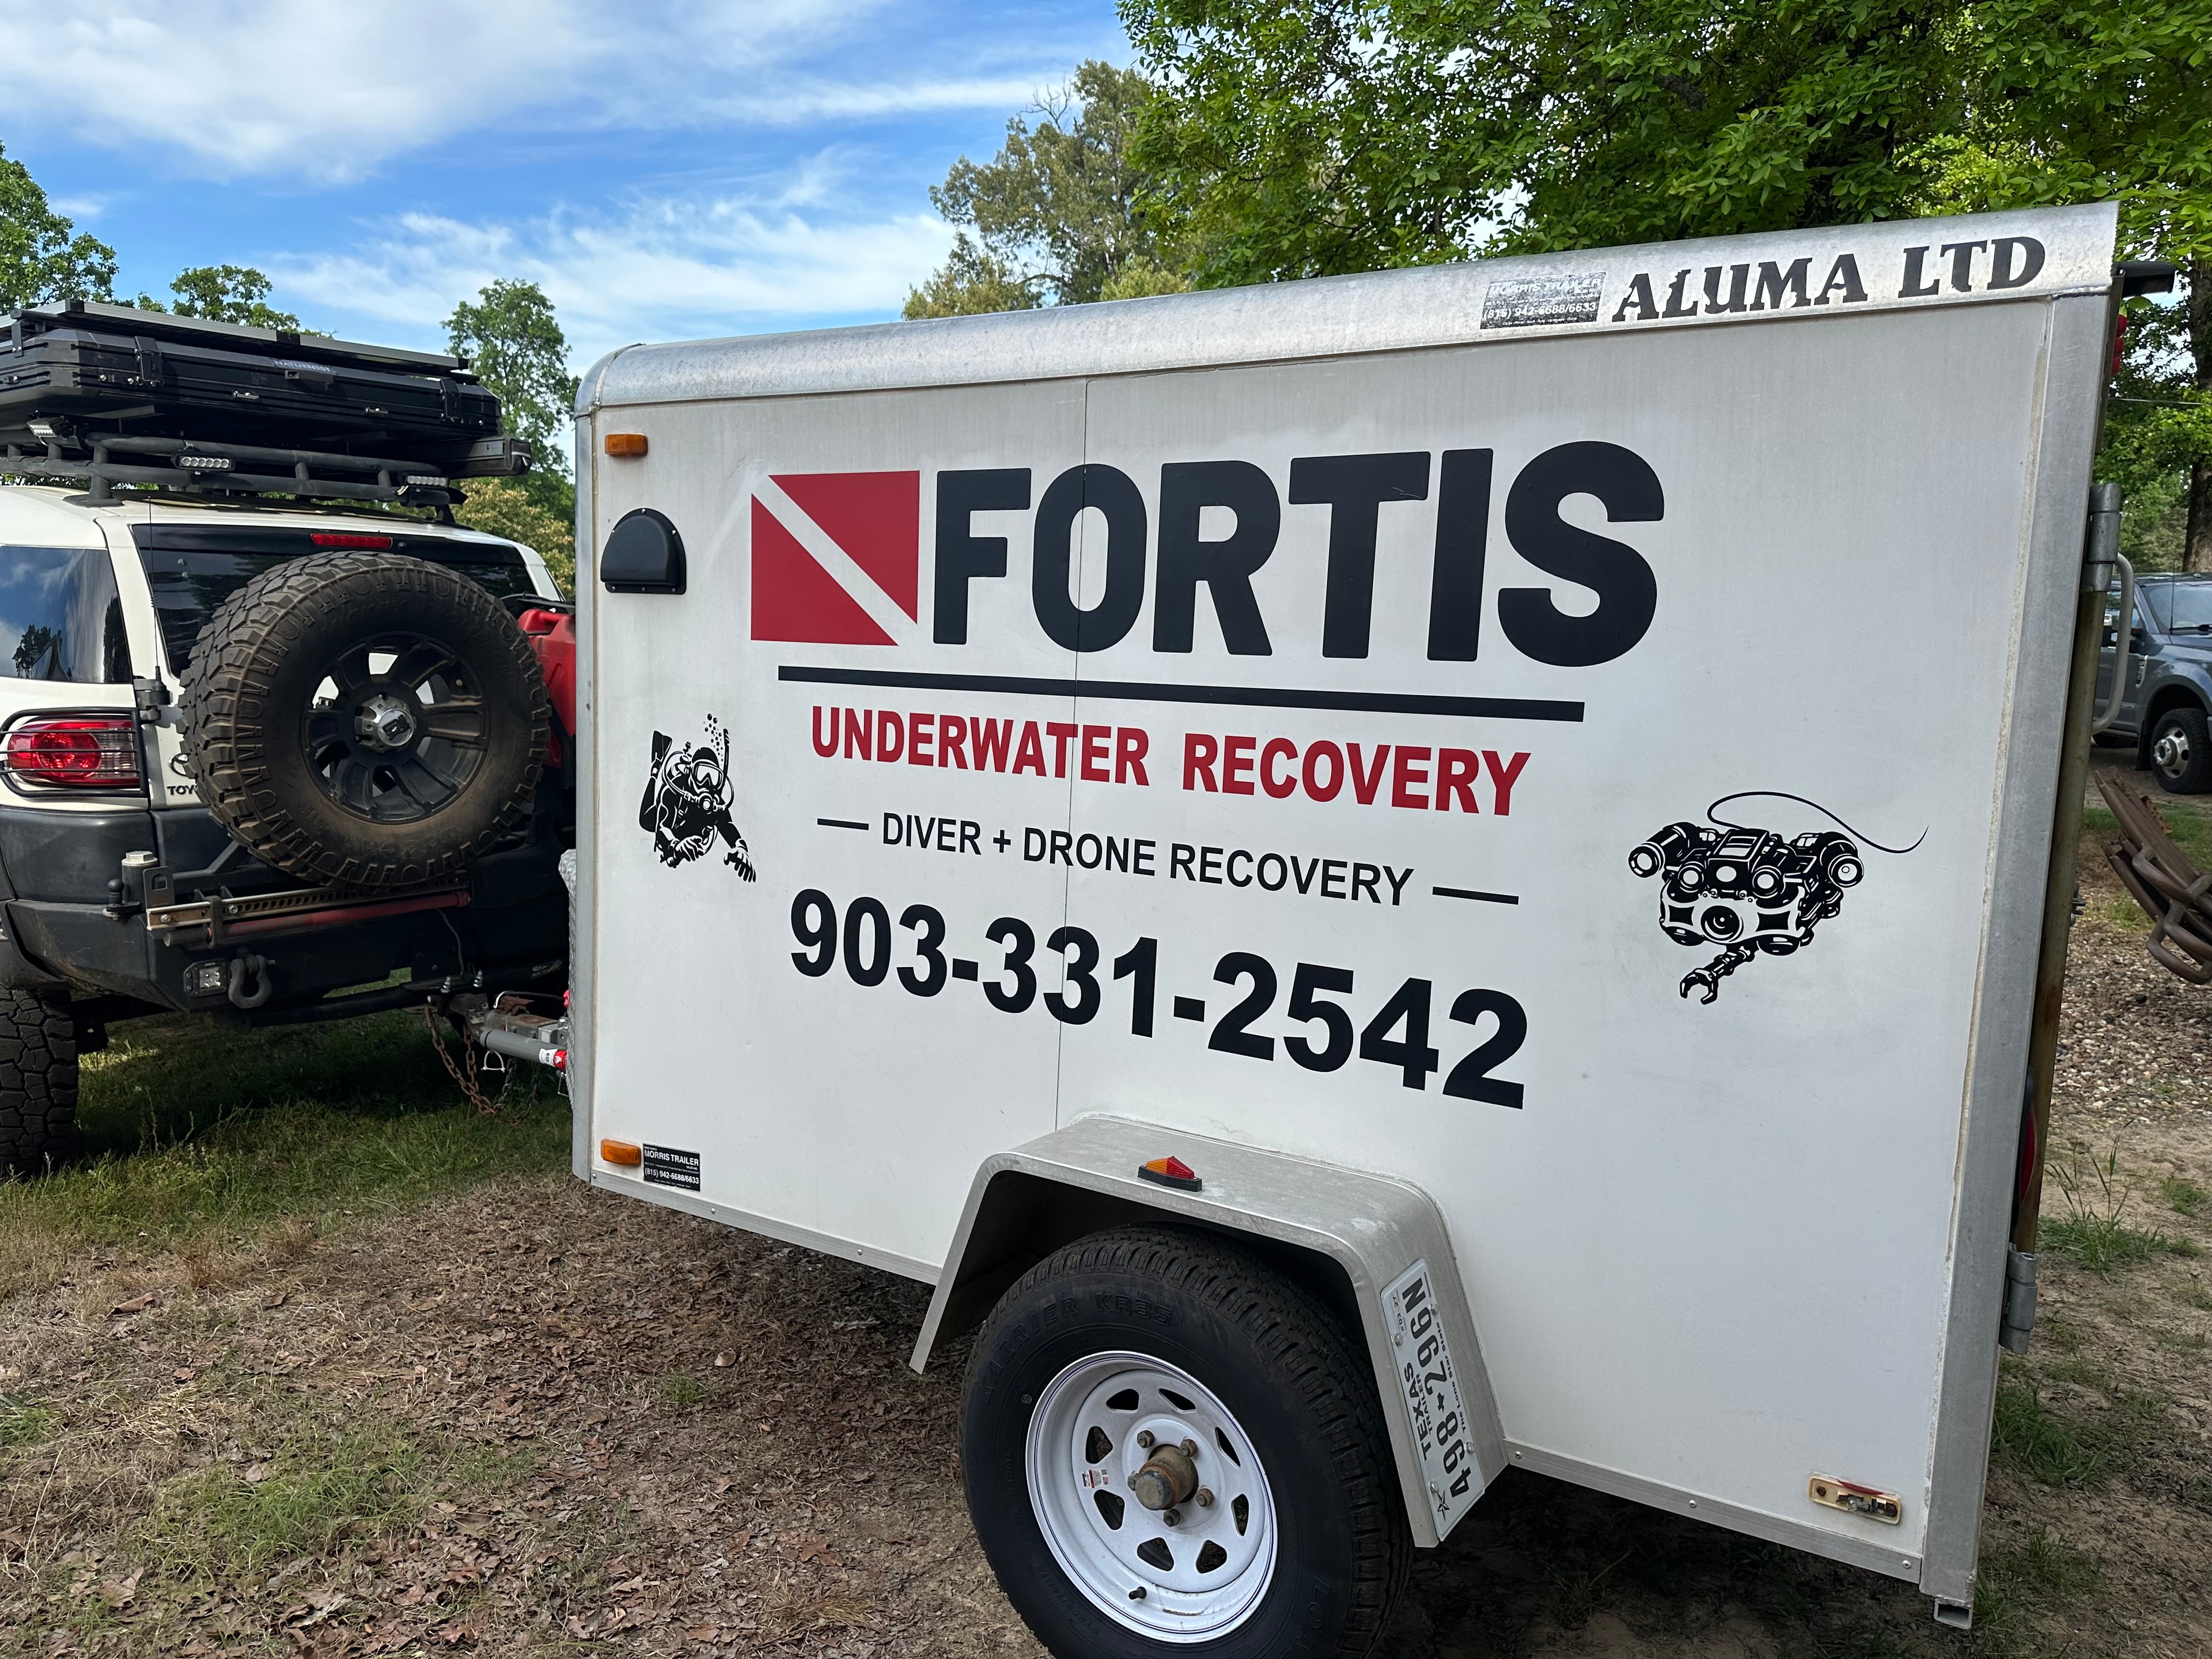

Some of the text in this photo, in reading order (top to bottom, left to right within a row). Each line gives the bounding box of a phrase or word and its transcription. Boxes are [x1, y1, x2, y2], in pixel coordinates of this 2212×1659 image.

[1612, 236, 2046, 323] ALUMA LTD
[932, 440, 1665, 668] FORTIS
[166, 785, 198, 795] TOY
[812, 706, 1532, 816] UNDERWATER RECOVERY
[882, 812, 1415, 906] DIVER + DRONE RECOVERY
[791, 888, 1528, 1110] 903-331-2542
[644, 1149, 699, 1166] MORRIS TRAILER
[645, 1167, 658, 1178] (815)
[659, 1170, 699, 1184] 942-6688/6633
[1437, 1322, 1446, 1352] State
[1404, 1362, 1431, 1461] TEXAS
[1416, 1372, 1433, 1434] TRAILER
[1452, 1381, 1461, 1409] Lone
